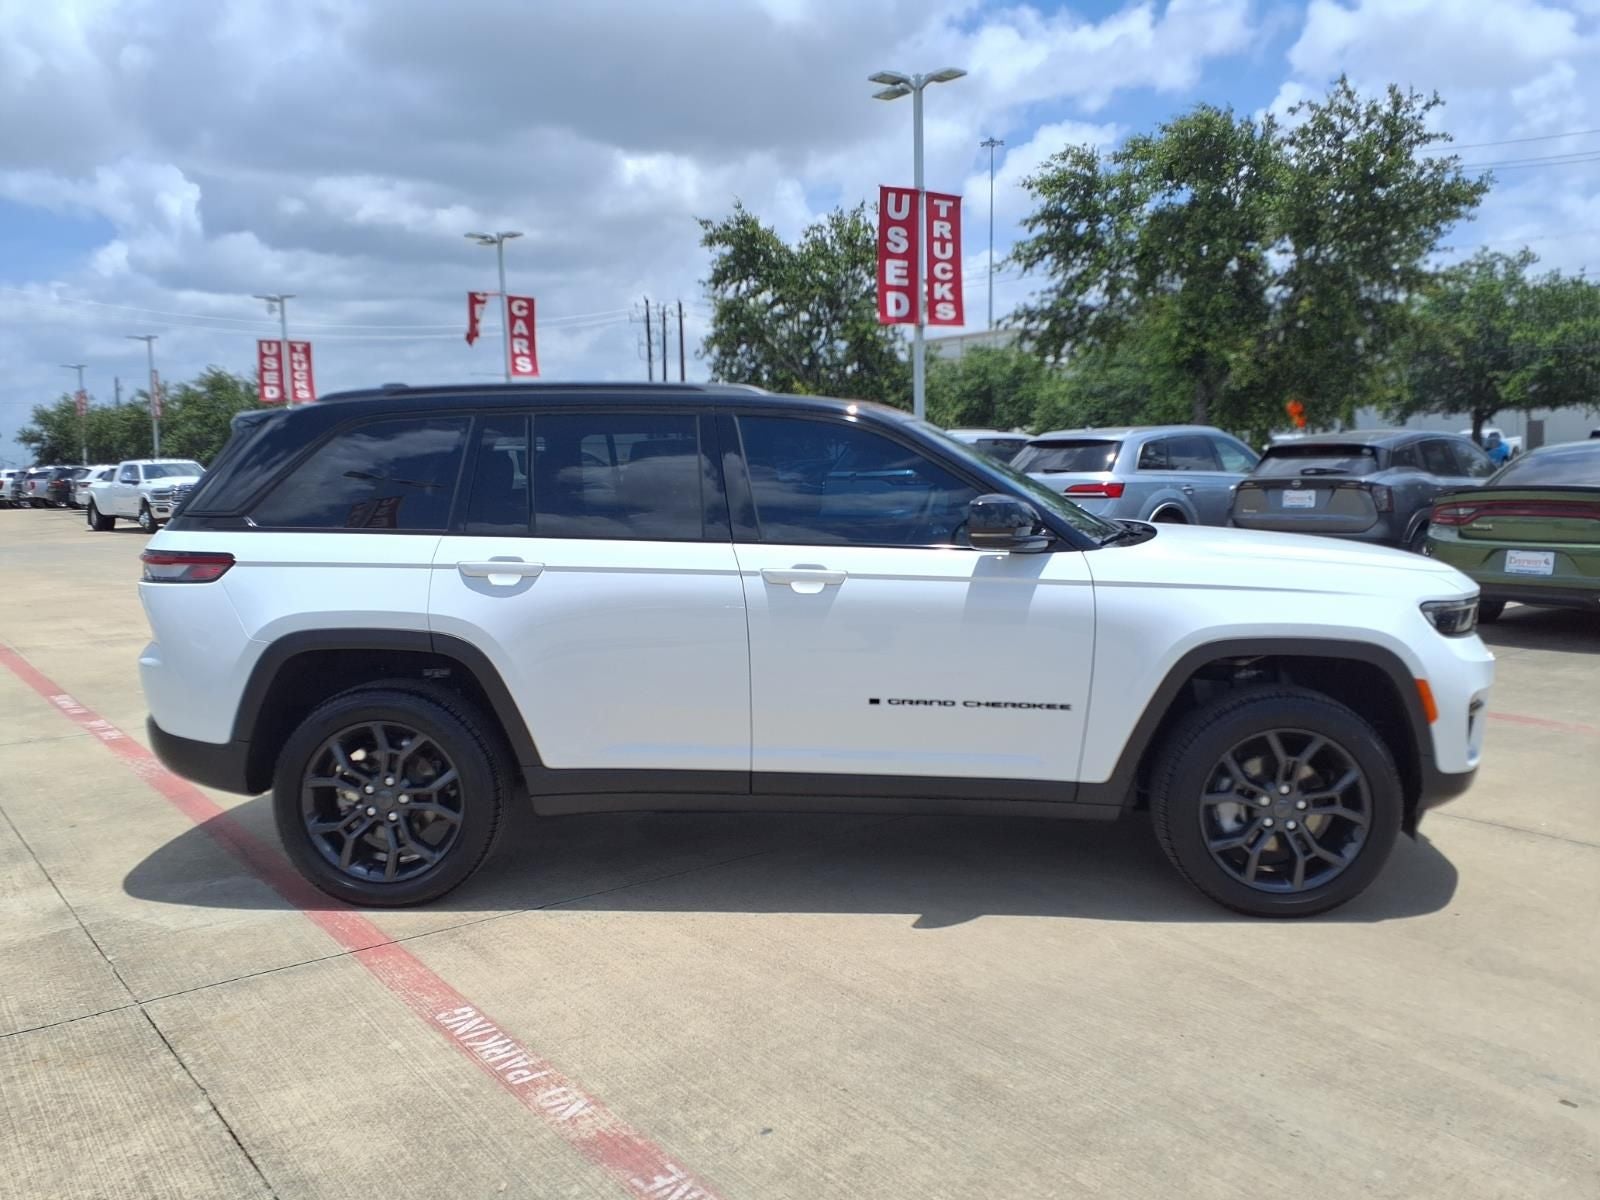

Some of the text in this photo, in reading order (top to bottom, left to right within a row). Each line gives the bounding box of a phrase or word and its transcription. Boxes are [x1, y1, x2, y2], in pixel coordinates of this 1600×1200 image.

[886, 192, 910, 318] USED
[932, 198, 957, 321] TRUCKS
[262, 342, 281, 399] USED
[510, 299, 533, 373] CARS
[887, 698, 1072, 711] GRAND CHEROKEE
[435, 1006, 550, 1086] PARKING
